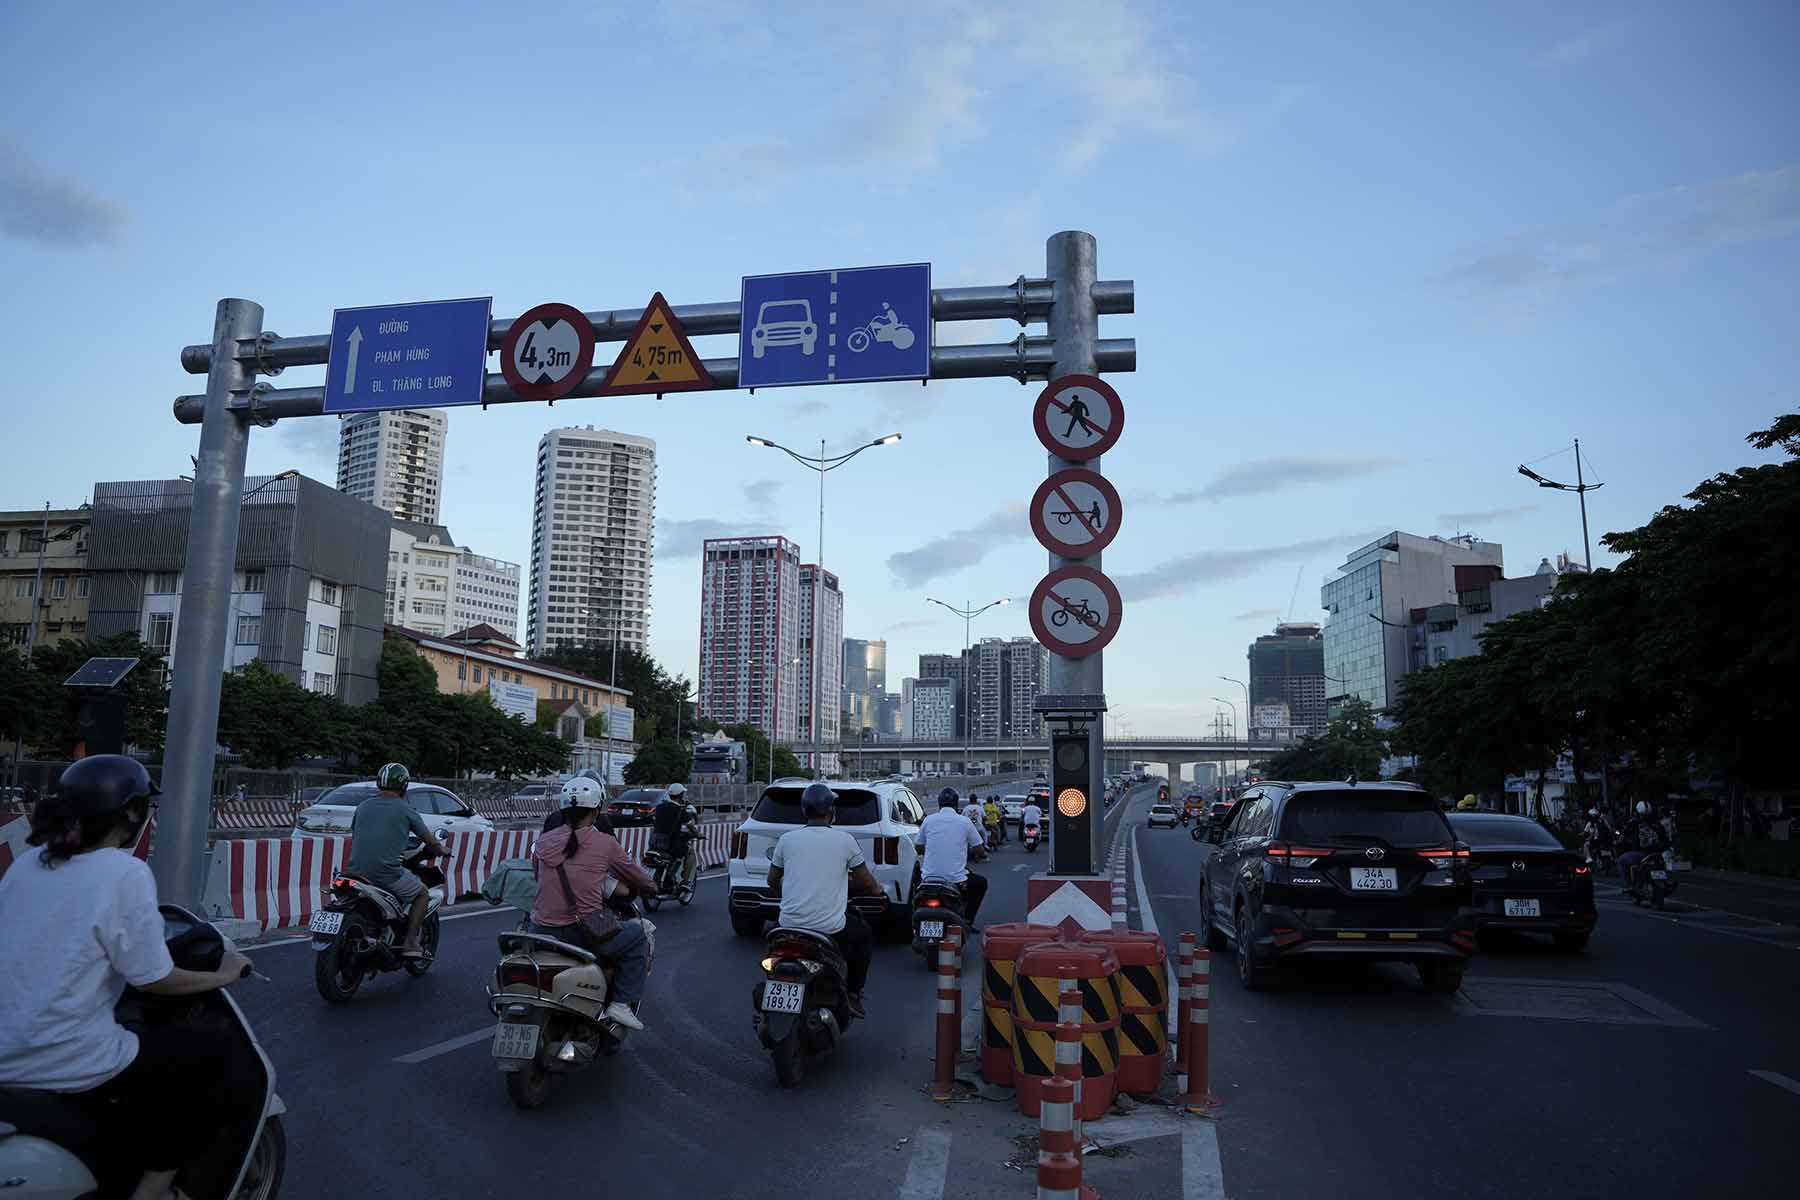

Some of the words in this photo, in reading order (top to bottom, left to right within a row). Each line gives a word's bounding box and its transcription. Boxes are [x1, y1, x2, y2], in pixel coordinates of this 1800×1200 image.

[519, 331, 571, 370] 4,3m
[633, 345, 682, 369] 4,75m
[374, 350, 401, 366] PHẠM
[428, 375, 453, 389] LONG
[1363, 868, 1384, 878] 34A
[1356, 879, 1392, 889] 442.30
[770, 983, 799, 997] 29-Y3
[766, 996, 799, 1010] 189.47
